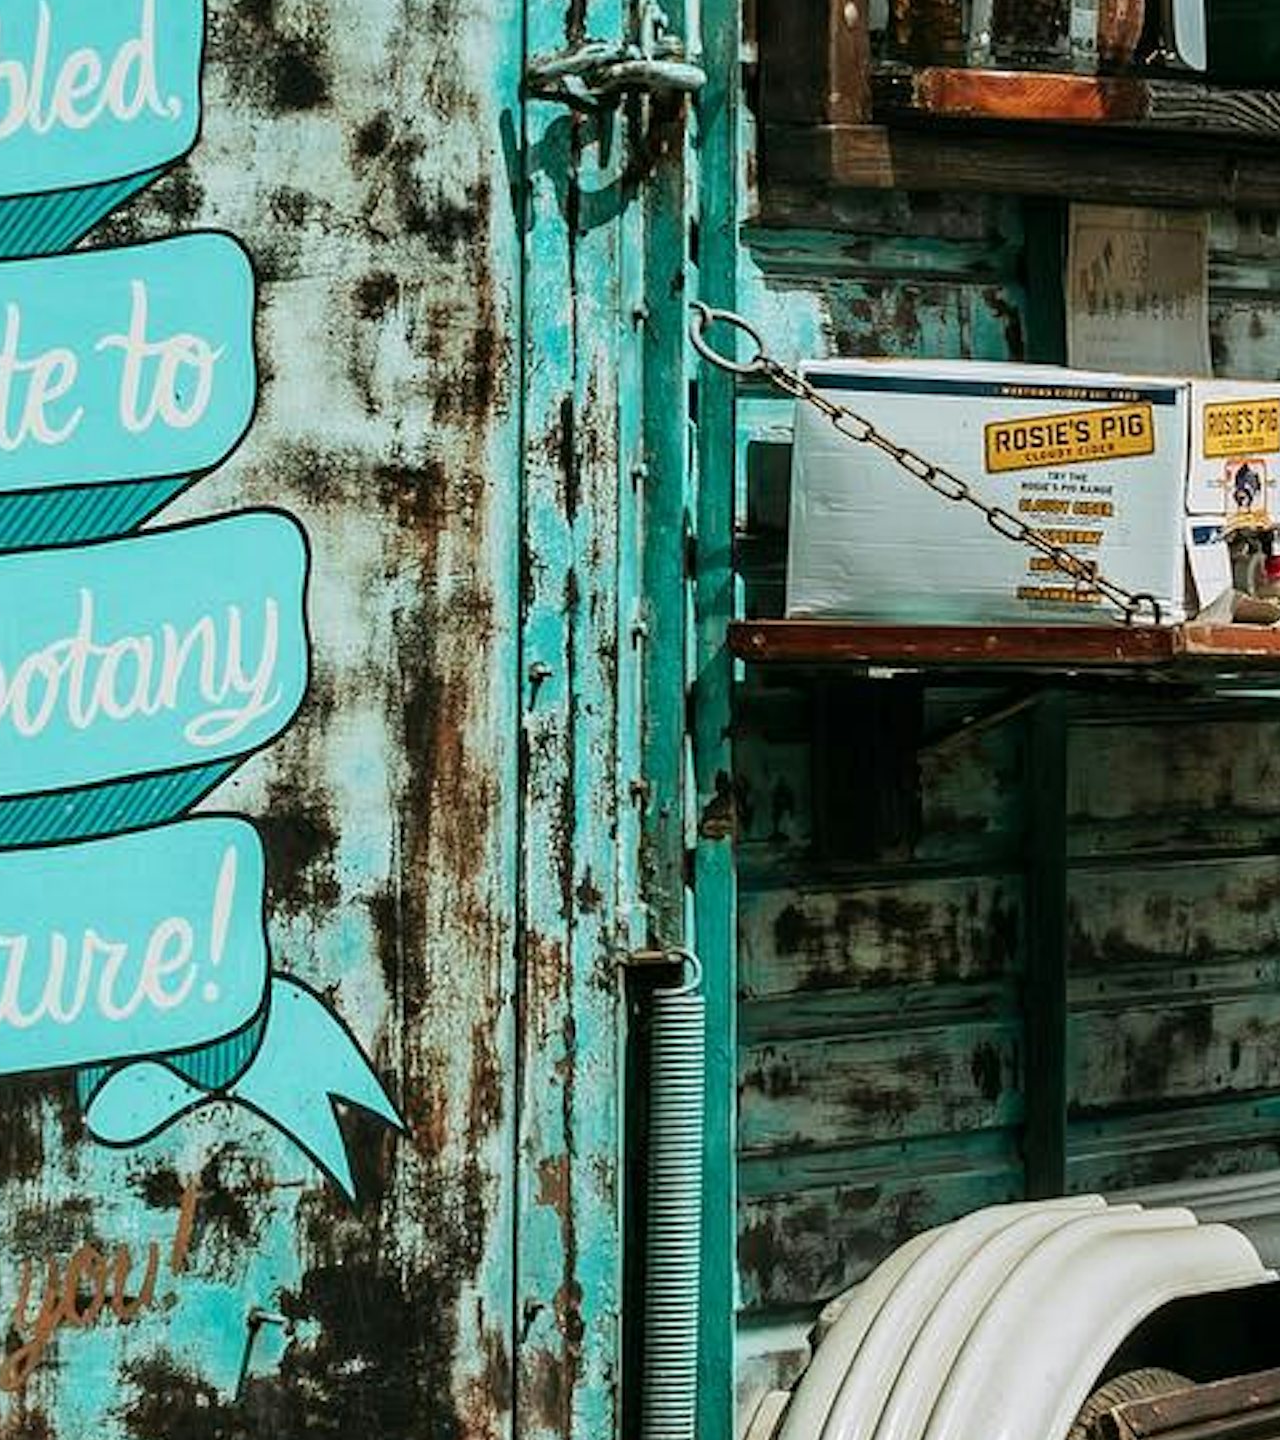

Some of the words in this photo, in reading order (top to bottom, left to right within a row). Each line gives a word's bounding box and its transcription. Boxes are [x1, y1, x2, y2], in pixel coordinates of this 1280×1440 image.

[96, 279, 224, 437] to
[995, 419, 1091, 454] ROSIE'S
[1101, 414, 1145, 440] PIG
[1025, 448, 1072, 463] CLOUDY
[1077, 443, 1115, 458] CIDER
